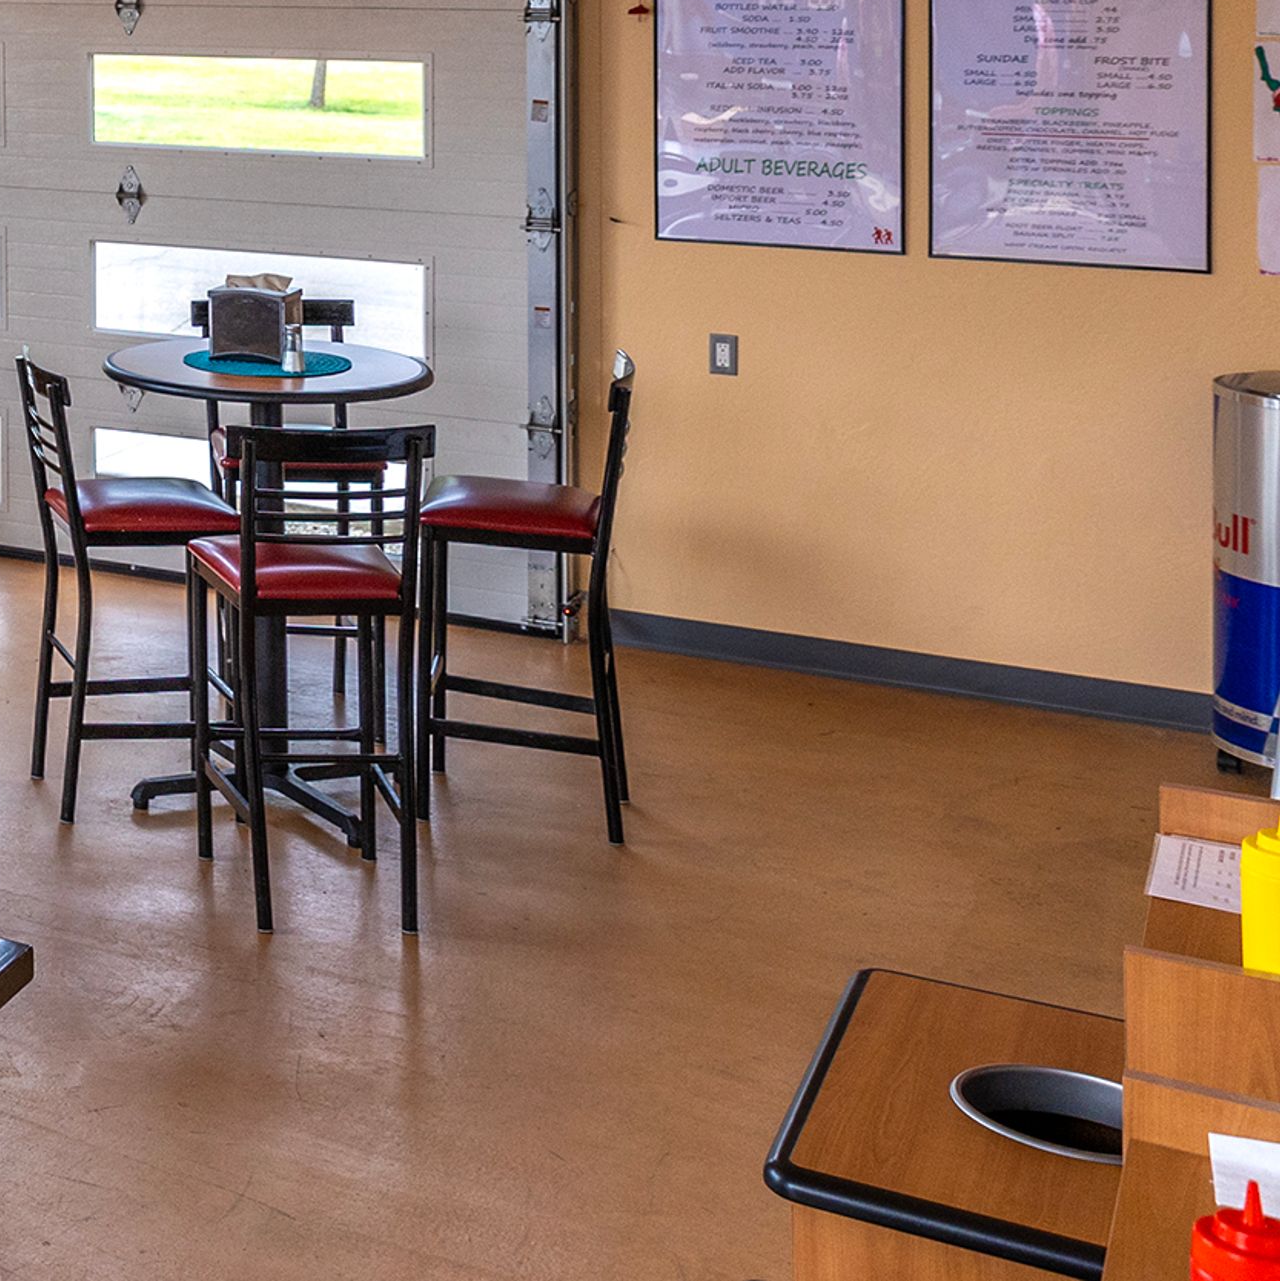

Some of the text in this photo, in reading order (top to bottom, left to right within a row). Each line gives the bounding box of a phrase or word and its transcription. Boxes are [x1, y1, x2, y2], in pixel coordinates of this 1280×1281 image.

[714, 2, 797, 12] BOTTLED WATER
[742, 15, 770, 23] SODA
[700, 26, 727, 35] FRUIT
[730, 27, 780, 35] SMOOTHIE
[732, 57, 755, 66] ICED
[758, 58, 778, 66] TEA
[977, 53, 1029, 64] SUNDAE
[1094, 55, 1171, 67] FROST BITE
[723, 67, 745, 75] ADD
[748, 67, 786, 76] FLAVOR
[963, 68, 996, 77] SMALL
[1096, 71, 1132, 80] SMALL
[747, 83, 775, 91] SODA
[964, 77, 997, 87] LARGE
[1096, 81, 1132, 90] LARGE
[1078, 91, 1117, 101] topping
[757, 106, 803, 115] INFUSION
[1032, 106, 1100, 118] TOPPINGS
[694, 156, 868, 180] ADULT BEVERAGES
[1007, 177, 1074, 189] SPECIALTY
[706, 184, 756, 193] DOMESTIC
[759, 186, 785, 195] BEER
[750, 195, 777, 204] BEER
[822, 199, 846, 207] 4.50
[713, 213, 762, 223] SELTZERS
[776, 216, 802, 224] TEAS
[1214, 510, 1248, 555] ull
